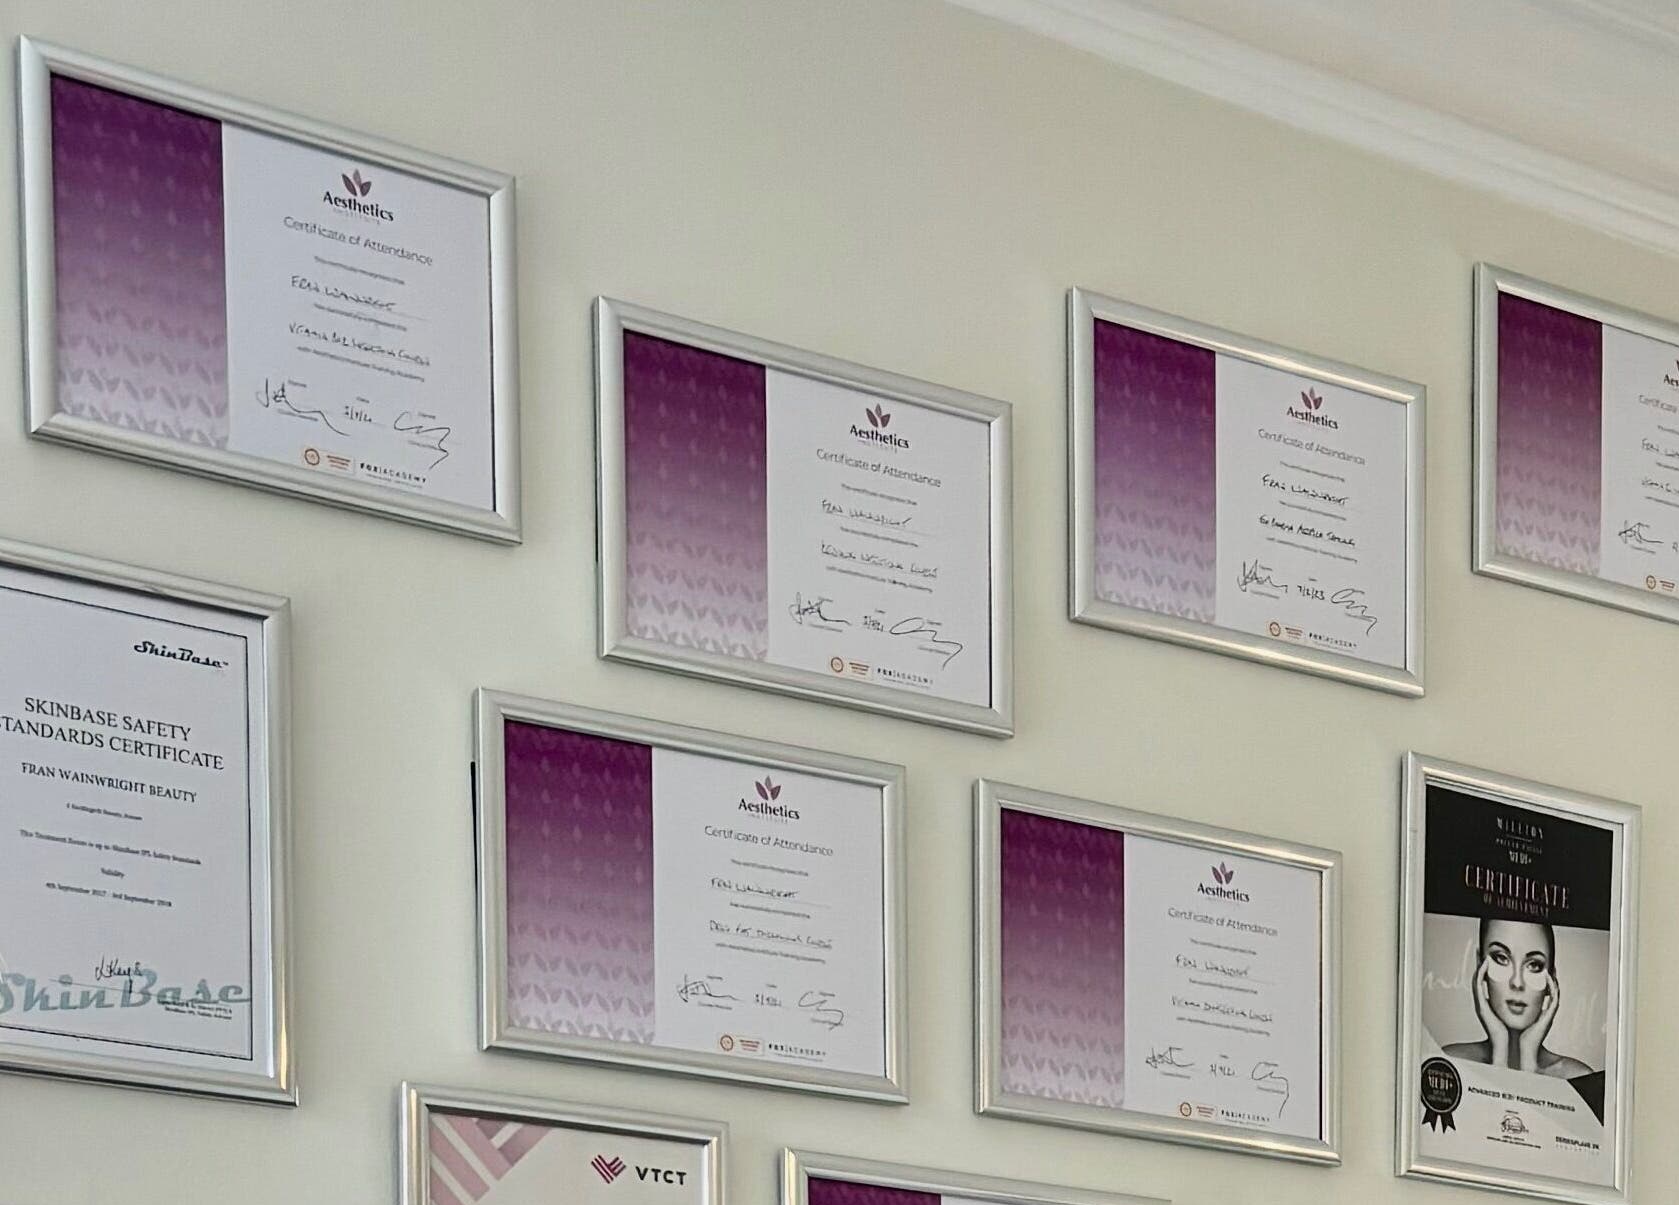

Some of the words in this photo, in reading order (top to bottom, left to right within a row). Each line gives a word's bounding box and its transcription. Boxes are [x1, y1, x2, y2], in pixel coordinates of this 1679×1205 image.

[323, 191, 394, 222] Aesthetics
[283, 215, 346, 243] Certificate
[348, 232, 361, 246] of
[363, 238, 433, 266] Attendance
[1287, 407, 1338, 430] Aesthetics
[850, 424, 910, 449] Aesthetics
[816, 448, 870, 471] Certificate
[883, 465, 942, 487] Attendance
[25, 697, 117, 727] SKINBASE
[123, 716, 191, 741] SAFETY
[0, 715, 104, 748] TANDARDS
[109, 737, 224, 770] CERTIFICATE
[22, 763, 55, 777] FRAN
[59, 769, 146, 794] WAINWRIGHT
[149, 785, 196, 803] BEAUTY
[738, 798, 800, 820] Aesthetics
[704, 826, 760, 844] Certificate
[773, 837, 834, 856] Attendance
[1197, 883, 1250, 902] Aesthetics
[1465, 864, 1569, 908] CERTIFICATE
[1168, 907, 1215, 925] Certificate
[1227, 919, 1278, 936] Attendance
[636, 1166, 687, 1185] VTCT
